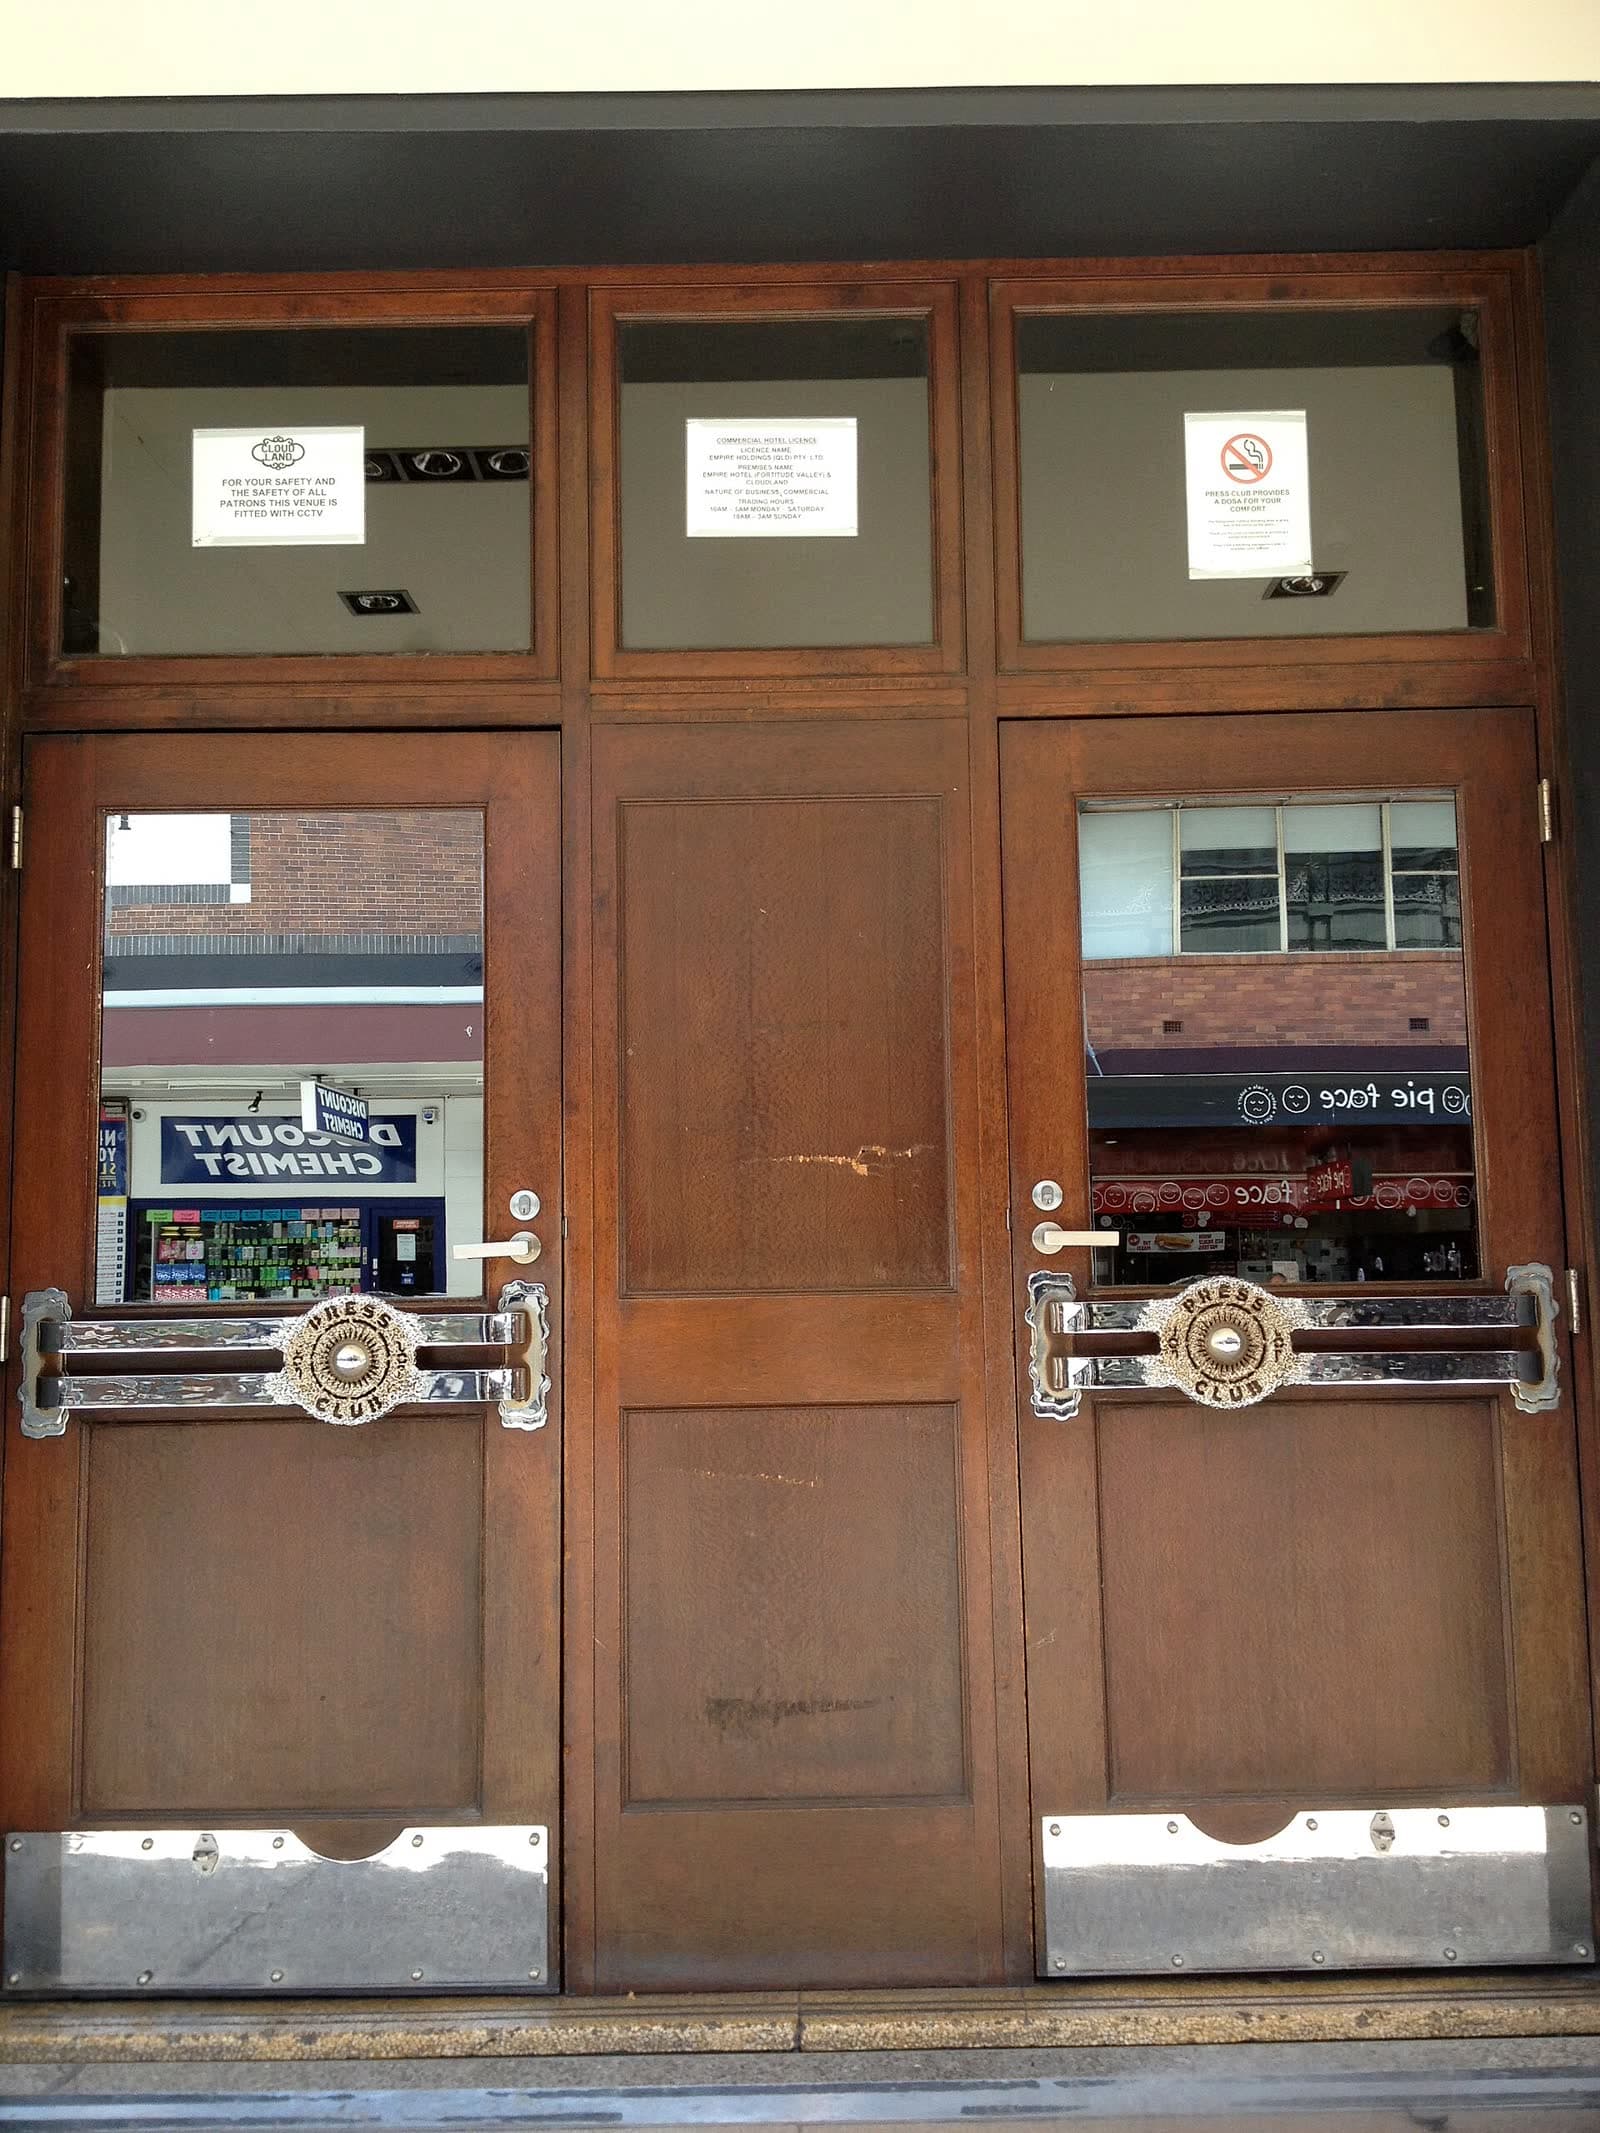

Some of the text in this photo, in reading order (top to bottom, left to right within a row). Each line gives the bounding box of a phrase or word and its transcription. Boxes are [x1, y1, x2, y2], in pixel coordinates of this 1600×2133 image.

[261, 444, 295, 453] CLOUD
[264, 452, 293, 462] LAND
[222, 477, 336, 487] FOR YOUR SAFETY AND
[231, 488, 327, 497] THE SAFETY OF ALL
[219, 498, 338, 508] PATRONS THIS VENUE IS
[234, 509, 323, 518] FITTED WITH CCTV
[1182, 1283, 1265, 1313] PRESS
[308, 1301, 392, 1330] PRESS
[1195, 1380, 1262, 1401] CLUB
[315, 1397, 382, 1419] CLUB
